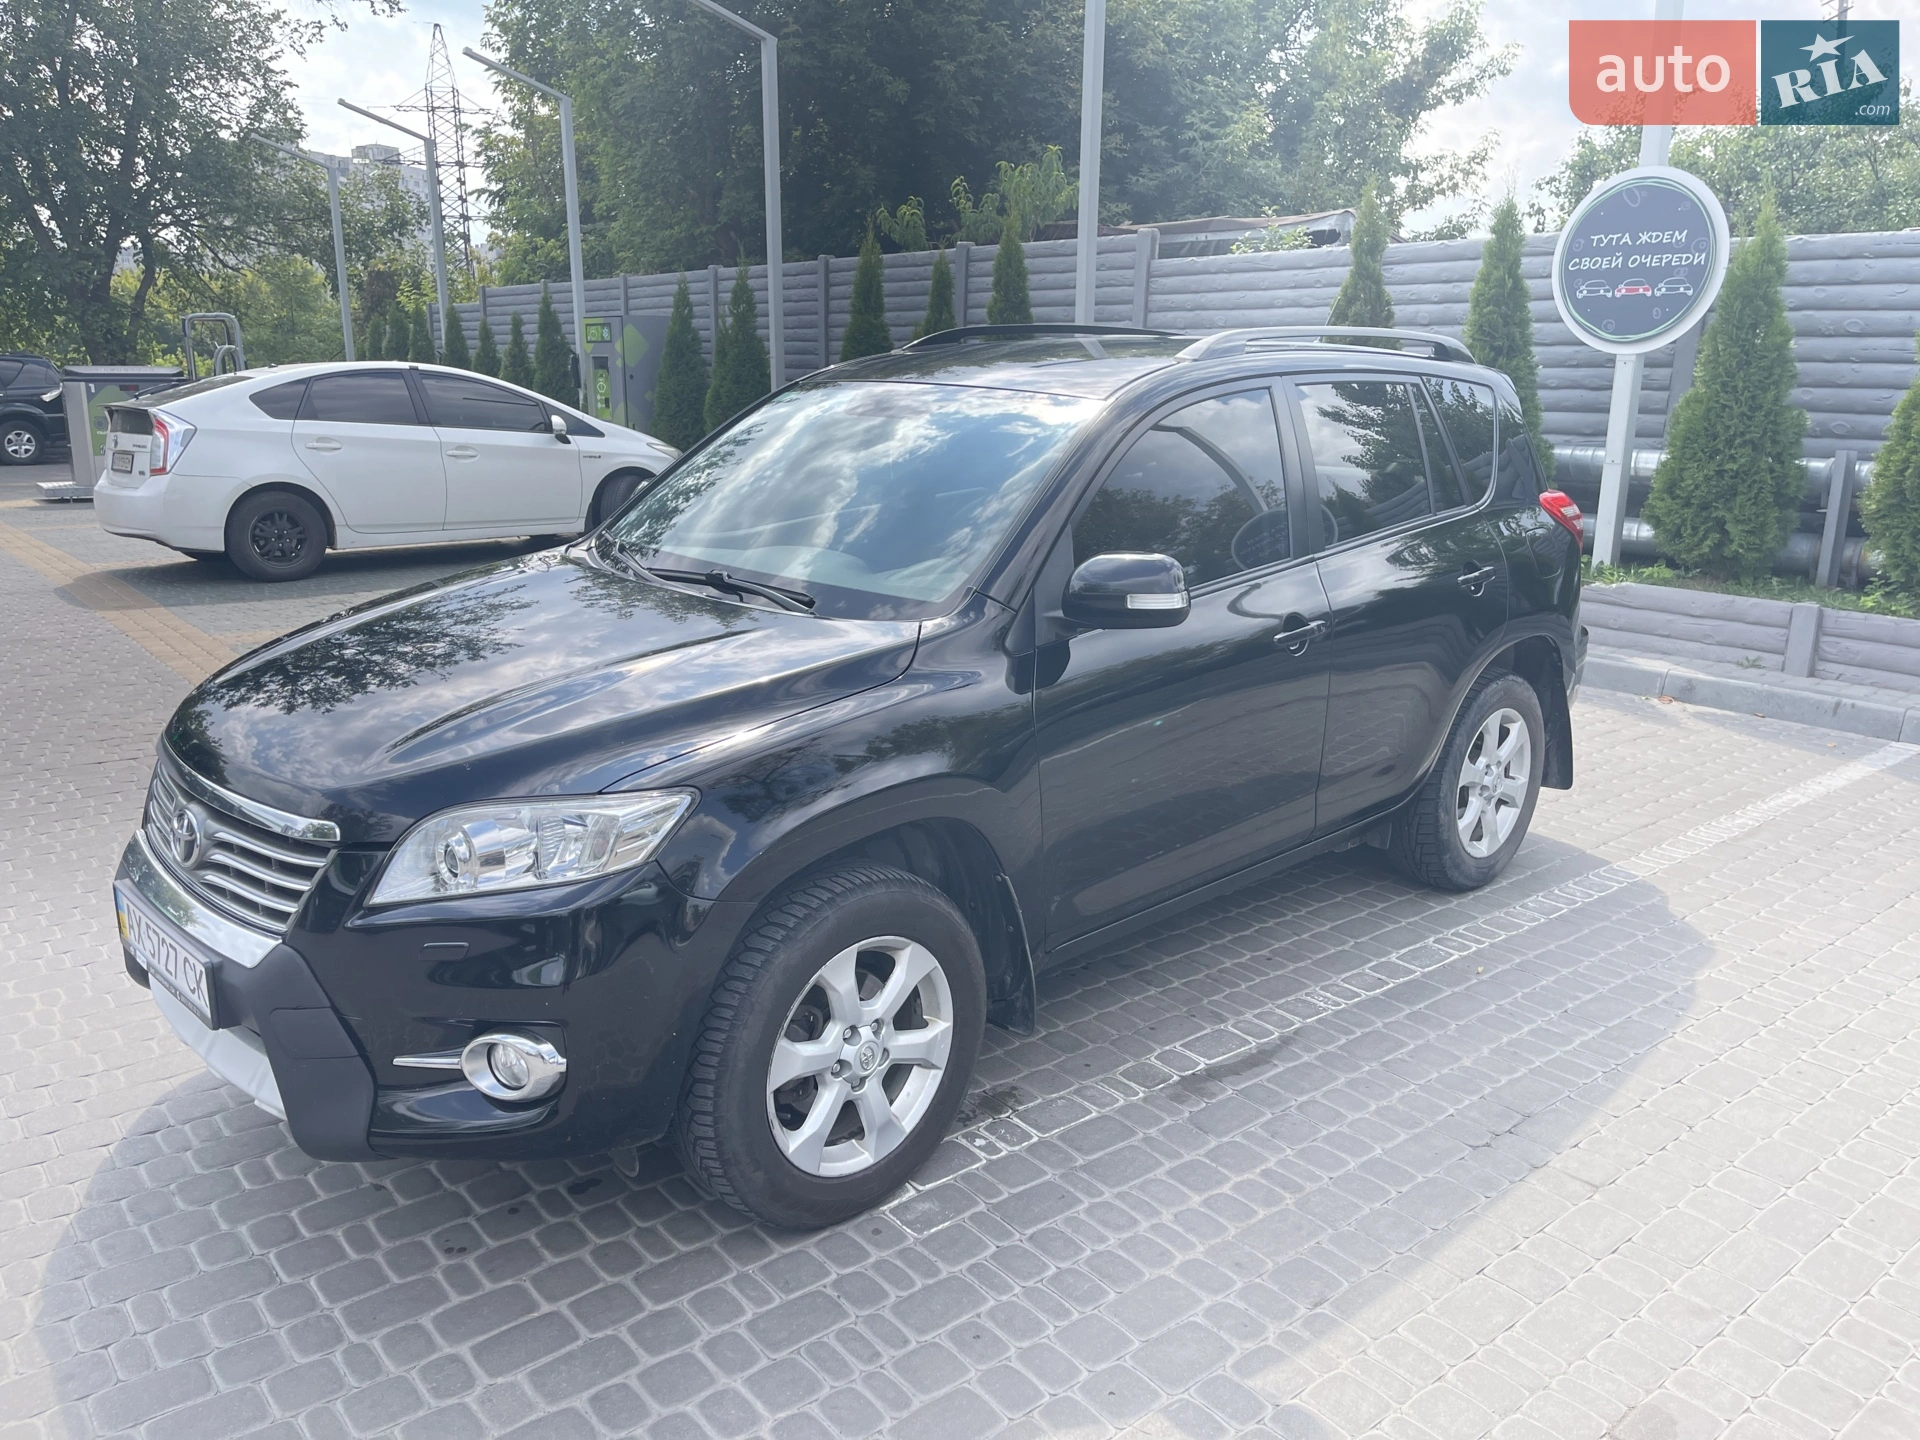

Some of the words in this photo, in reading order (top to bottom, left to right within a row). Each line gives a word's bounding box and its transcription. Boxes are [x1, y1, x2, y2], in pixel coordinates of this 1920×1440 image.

[1590, 232, 1632, 247] ТУТА
[1636, 229, 1688, 246] ЖДЕМ
[1568, 252, 1623, 271] СВОЕЙ
[1628, 252, 1706, 269] ОЧЕРЕДИ
[147, 922, 178, 981] 5727
